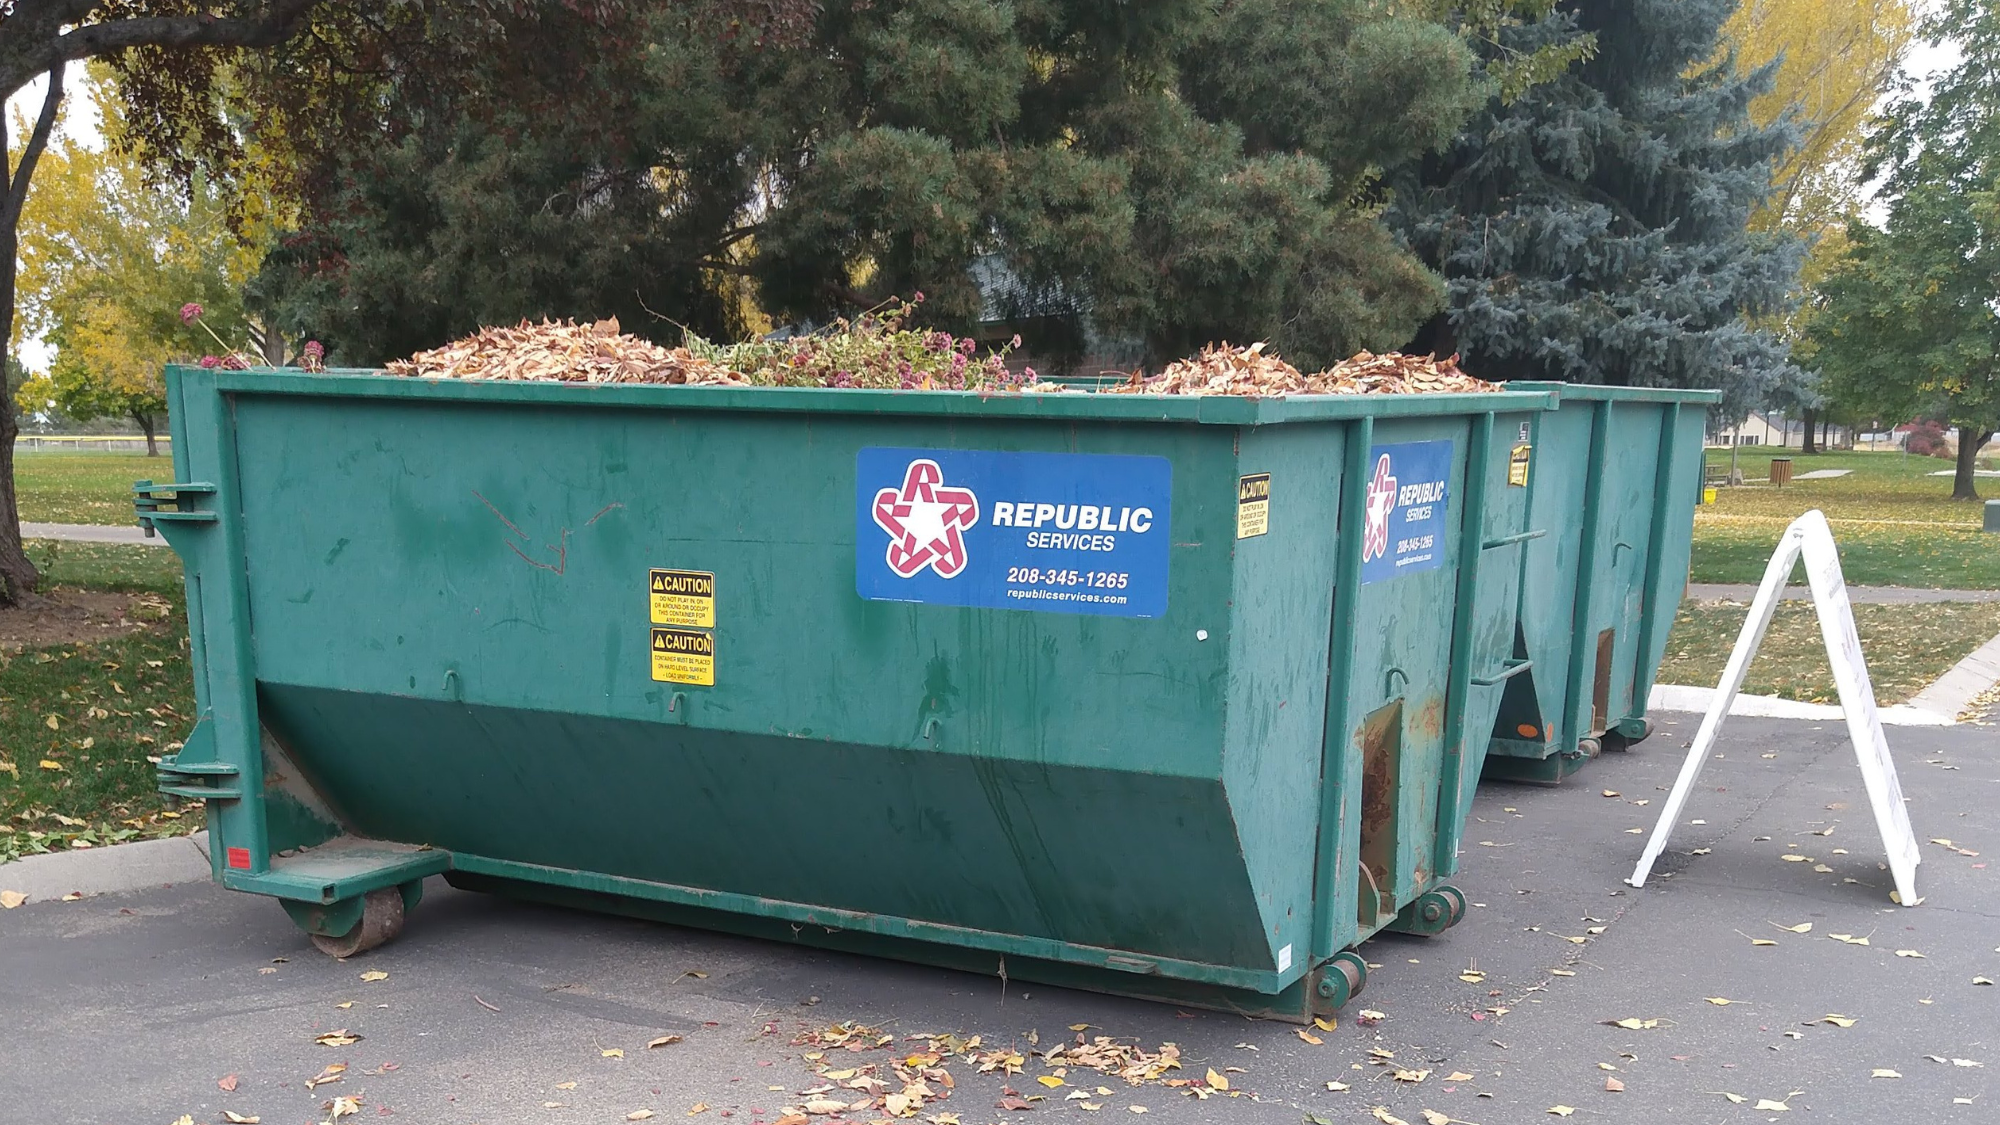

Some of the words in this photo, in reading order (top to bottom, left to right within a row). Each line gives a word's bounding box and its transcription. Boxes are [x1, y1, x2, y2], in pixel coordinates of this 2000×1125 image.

[1246, 480, 1269, 499] CAUTION
[1398, 480, 1445, 507] REPUBLIC
[992, 501, 1153, 533] REPUBLIC
[1406, 505, 1432, 522] SERVICES
[1026, 531, 1115, 552] SERVICES
[664, 576, 711, 594] CAUTION
[1006, 567, 1129, 589] 208-345-1265
[1007, 589, 1128, 605] republicservices.com
[669, 610, 695, 618] CONTAINER
[665, 634, 711, 653] CAUTION
